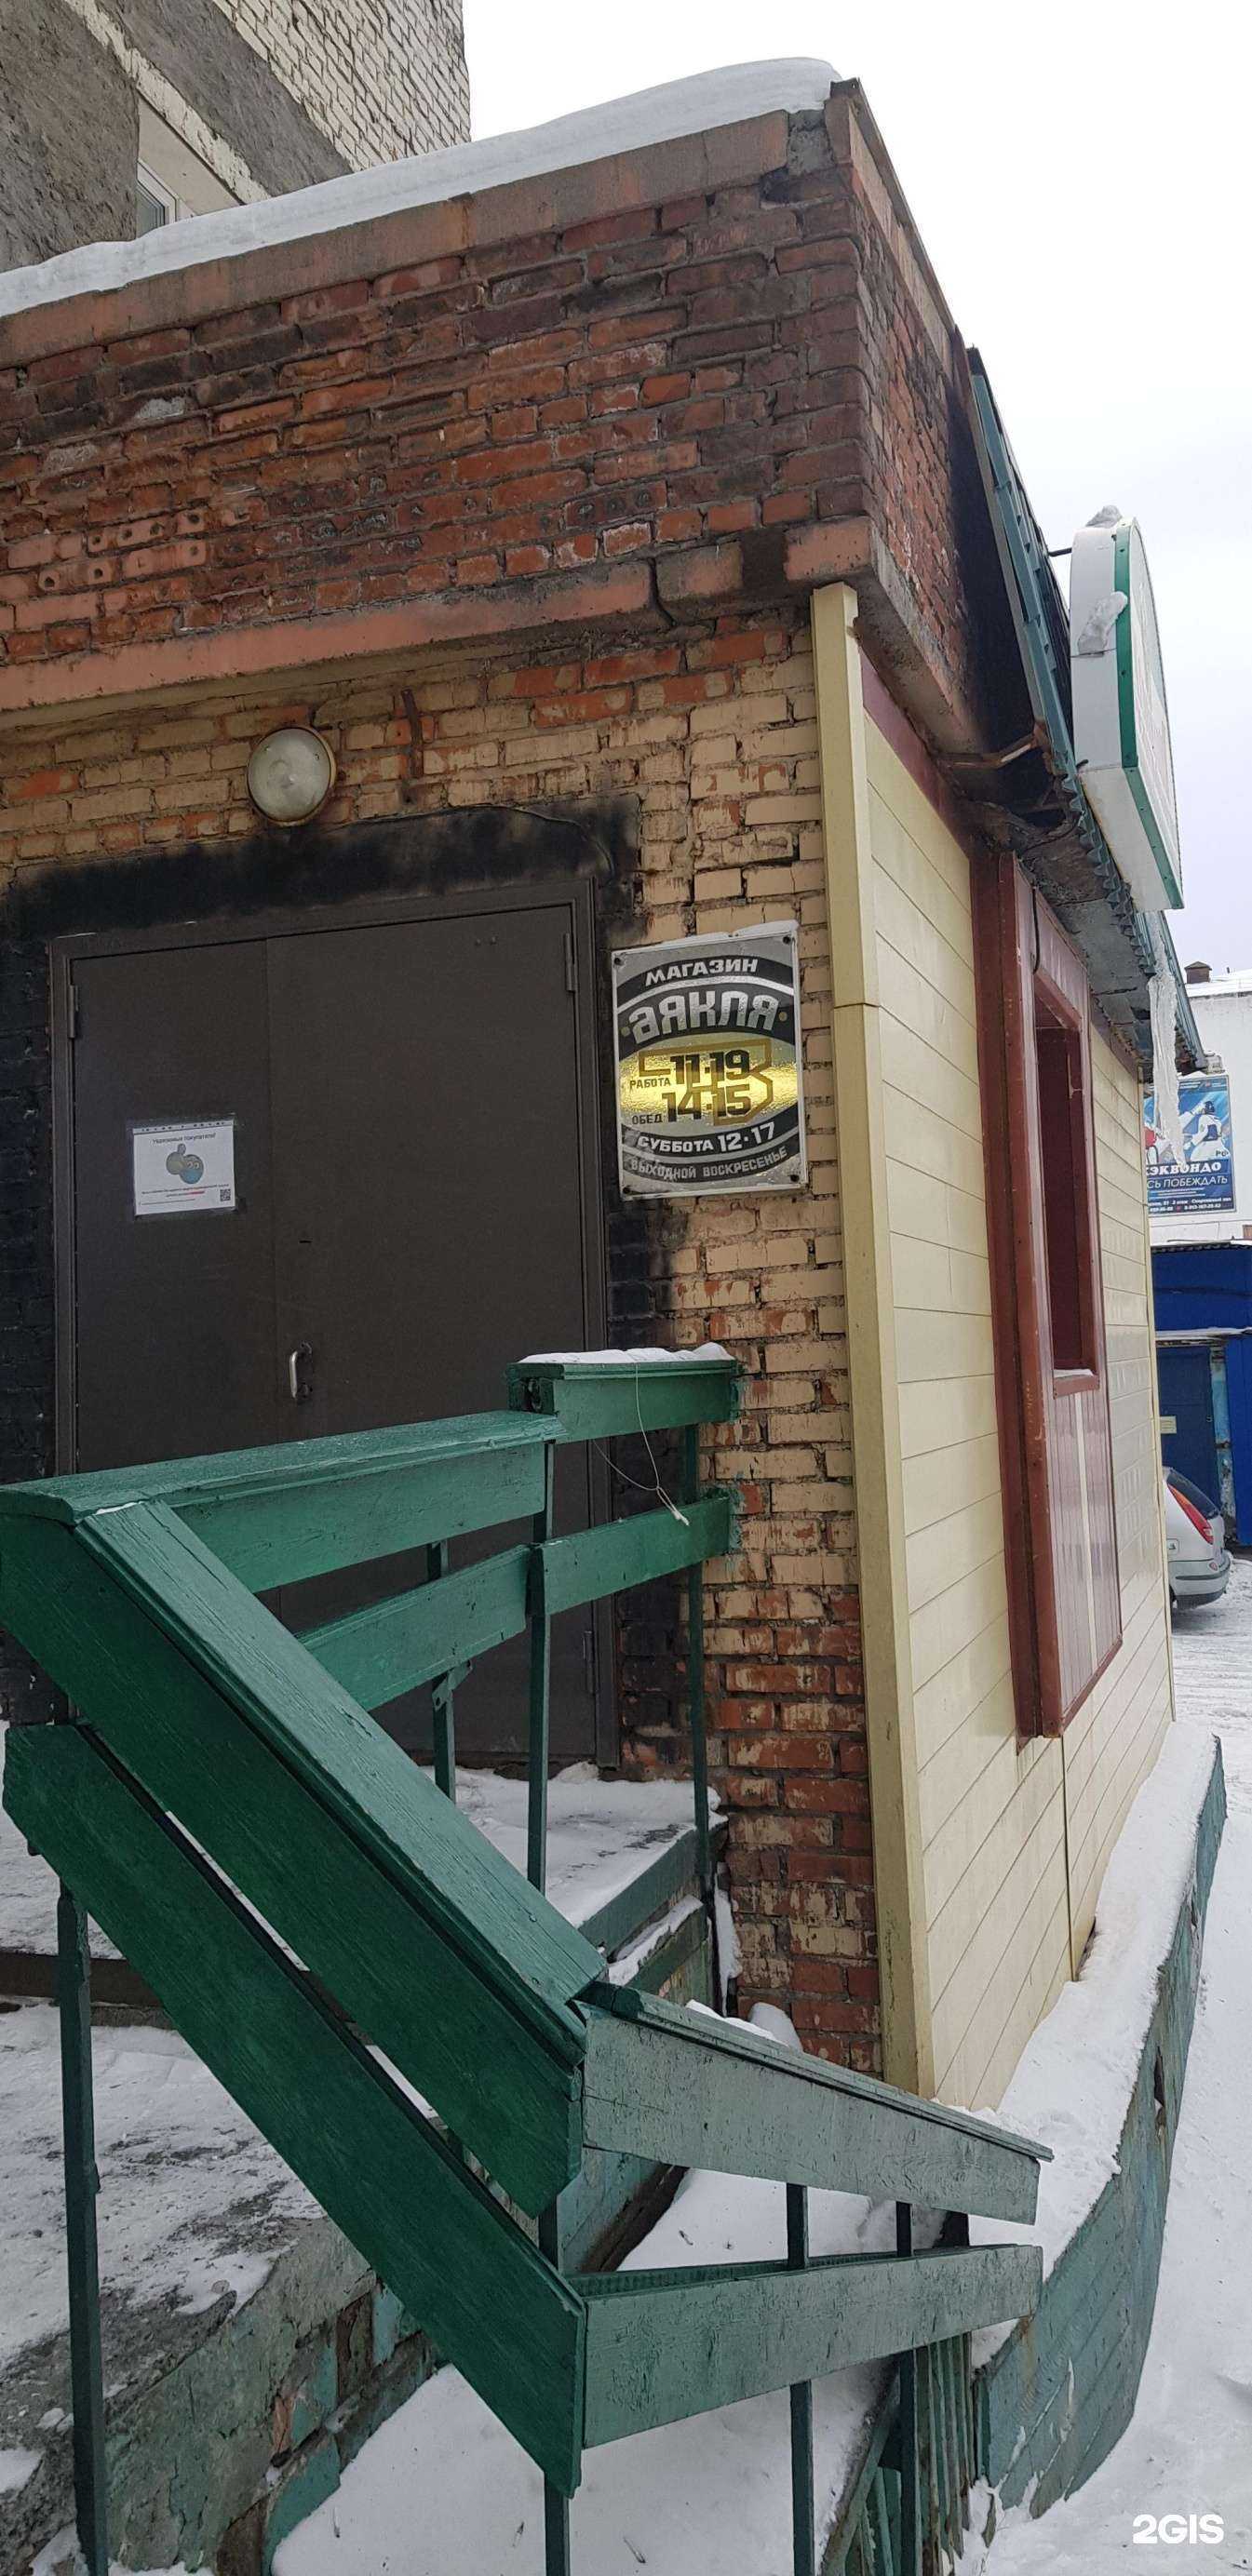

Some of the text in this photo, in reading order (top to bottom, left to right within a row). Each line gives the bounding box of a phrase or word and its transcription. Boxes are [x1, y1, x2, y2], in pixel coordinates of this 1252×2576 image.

[645, 958, 758, 987] МАГАЗИН
[629, 1077, 671, 1091] РАБОТА
[632, 1113, 664, 1126] ОБЕД
[638, 1134, 713, 1154] СУББОТА
[630, 1146, 788, 1180] ВЫХОДНОЙ ВОСКРЕСЕНЬЕ
[1164, 1175, 1228, 1187] ПОБЕЖДАТЬ
